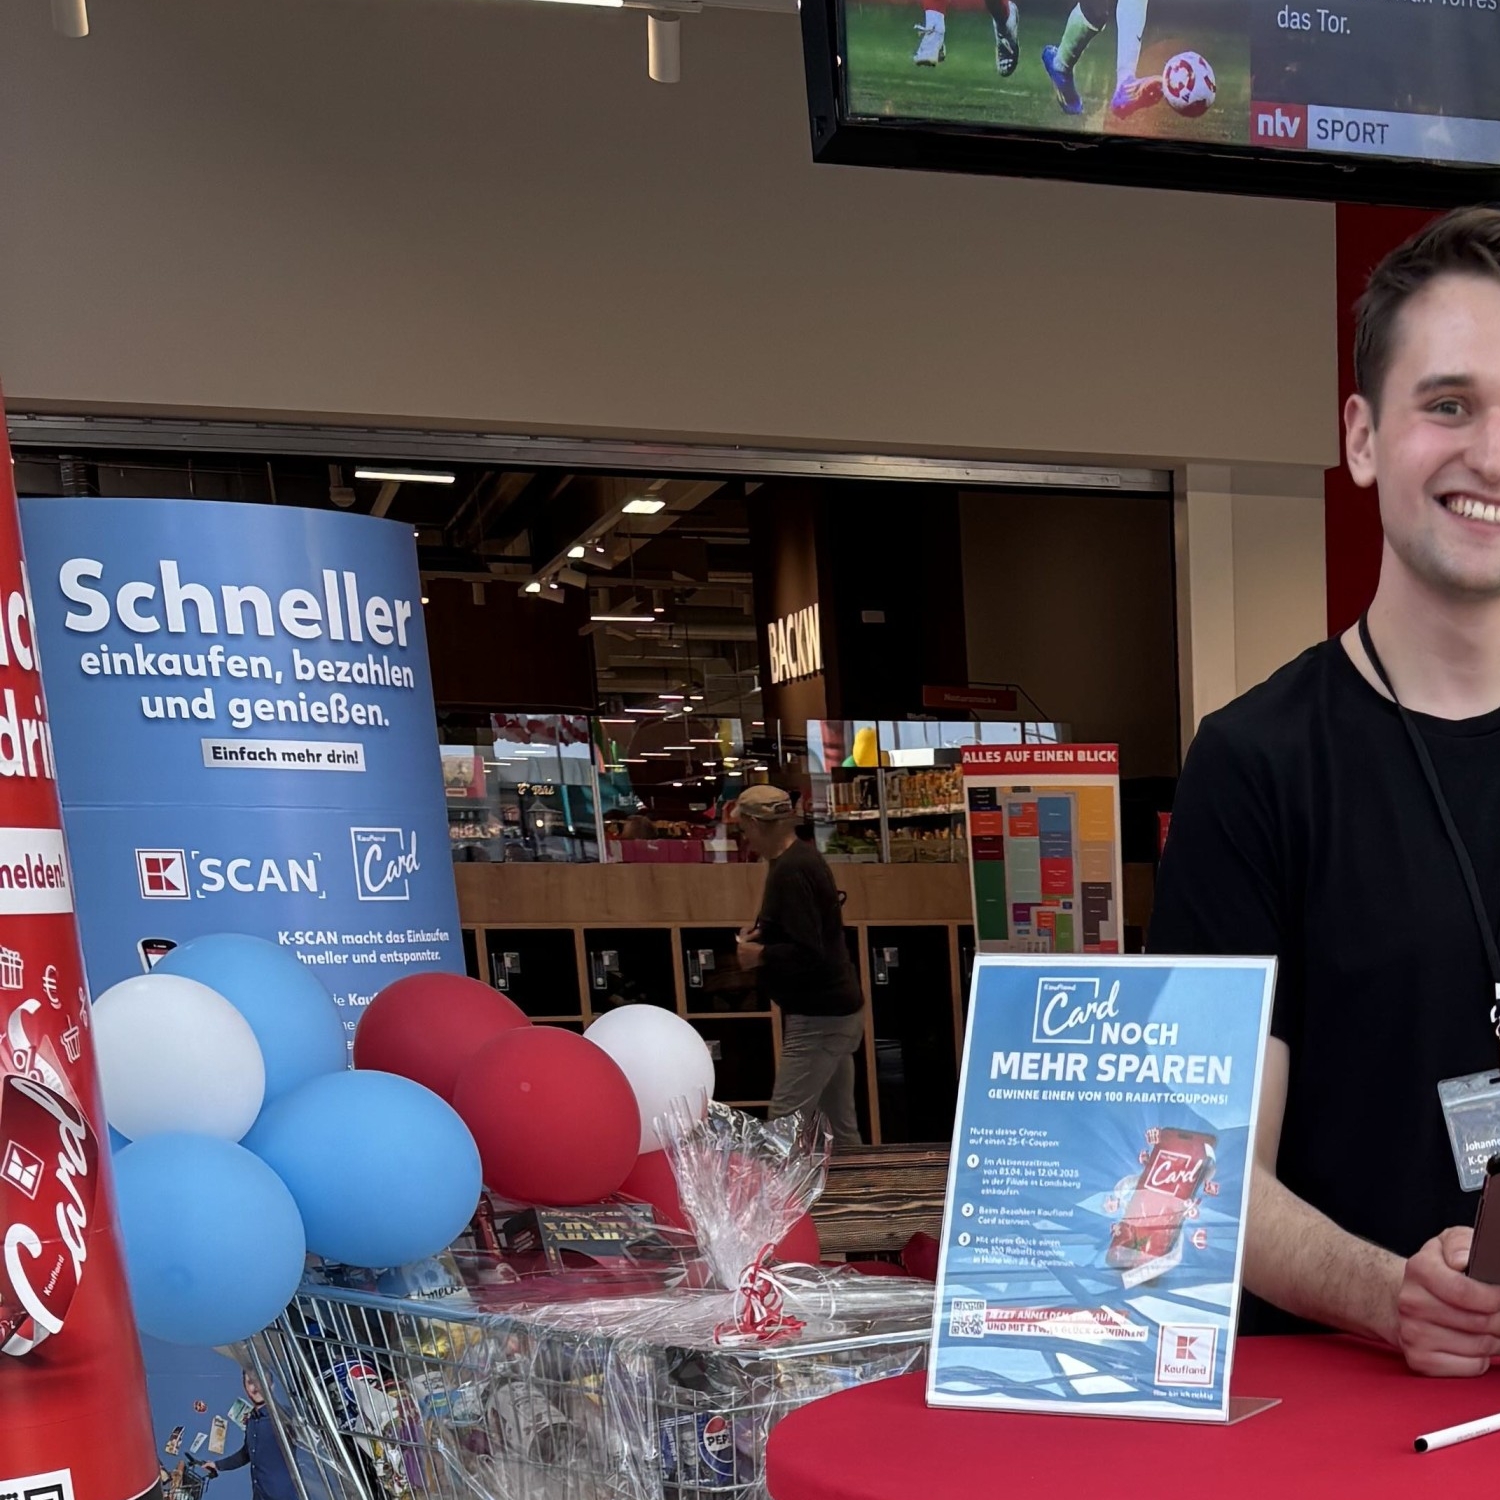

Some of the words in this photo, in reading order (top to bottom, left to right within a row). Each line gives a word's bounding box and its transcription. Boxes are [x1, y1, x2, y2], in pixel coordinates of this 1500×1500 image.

[1277, 5, 1311, 30] das
[1317, 9, 1351, 35] Tor.
[1257, 108, 1301, 138] ntv
[1316, 118, 1389, 145] SPORT
[59, 557, 413, 647] Schneller
[80, 643, 283, 684] einkaufen,
[293, 648, 415, 689] bezahlen
[141, 688, 215, 720] und
[229, 691, 390, 729] genießen.
[212, 745, 277, 763] Einfach
[281, 748, 322, 764] mehr
[327, 749, 359, 766] drin!
[962, 751, 1001, 763] ALLES
[1004, 750, 1031, 762] AUF
[1033, 750, 1073, 763] EINEN
[1077, 750, 1117, 763] BLICK
[201, 858, 318, 893] SCAN
[363, 830, 421, 893] Card
[278, 931, 338, 945] K-SCAN
[342, 931, 383, 944] macht
[386, 930, 405, 943] das
[407, 928, 449, 943] Einkaufen
[297, 951, 348, 965] hneller
[352, 950, 376, 964] und
[380, 949, 441, 965] entspannter.
[1042, 980, 1120, 1036] Card
[1100, 1022, 1179, 1046] NOCH
[990, 1052, 1088, 1082] MEHR
[1096, 1053, 1233, 1085] SPAREN
[988, 1089, 1039, 1100] GEWINNE
[1042, 1090, 1074, 1101] EINEN
[1077, 1091, 1101, 1102] VON
[1104, 1092, 1123, 1102] 100
[1126, 1093, 1228, 1105] RABATTCOUPONS!
[1153, 1161, 1204, 1188] Card
[4, 1077, 88, 1334] Card
[43, 1255, 64, 1296] Kaufland
[987, 1322, 1006, 1332] UND
[1008, 1323, 1025, 1333] MIT
[1163, 1364, 1207, 1376] Kaufland
[707, 1433, 728, 1447] PEP
